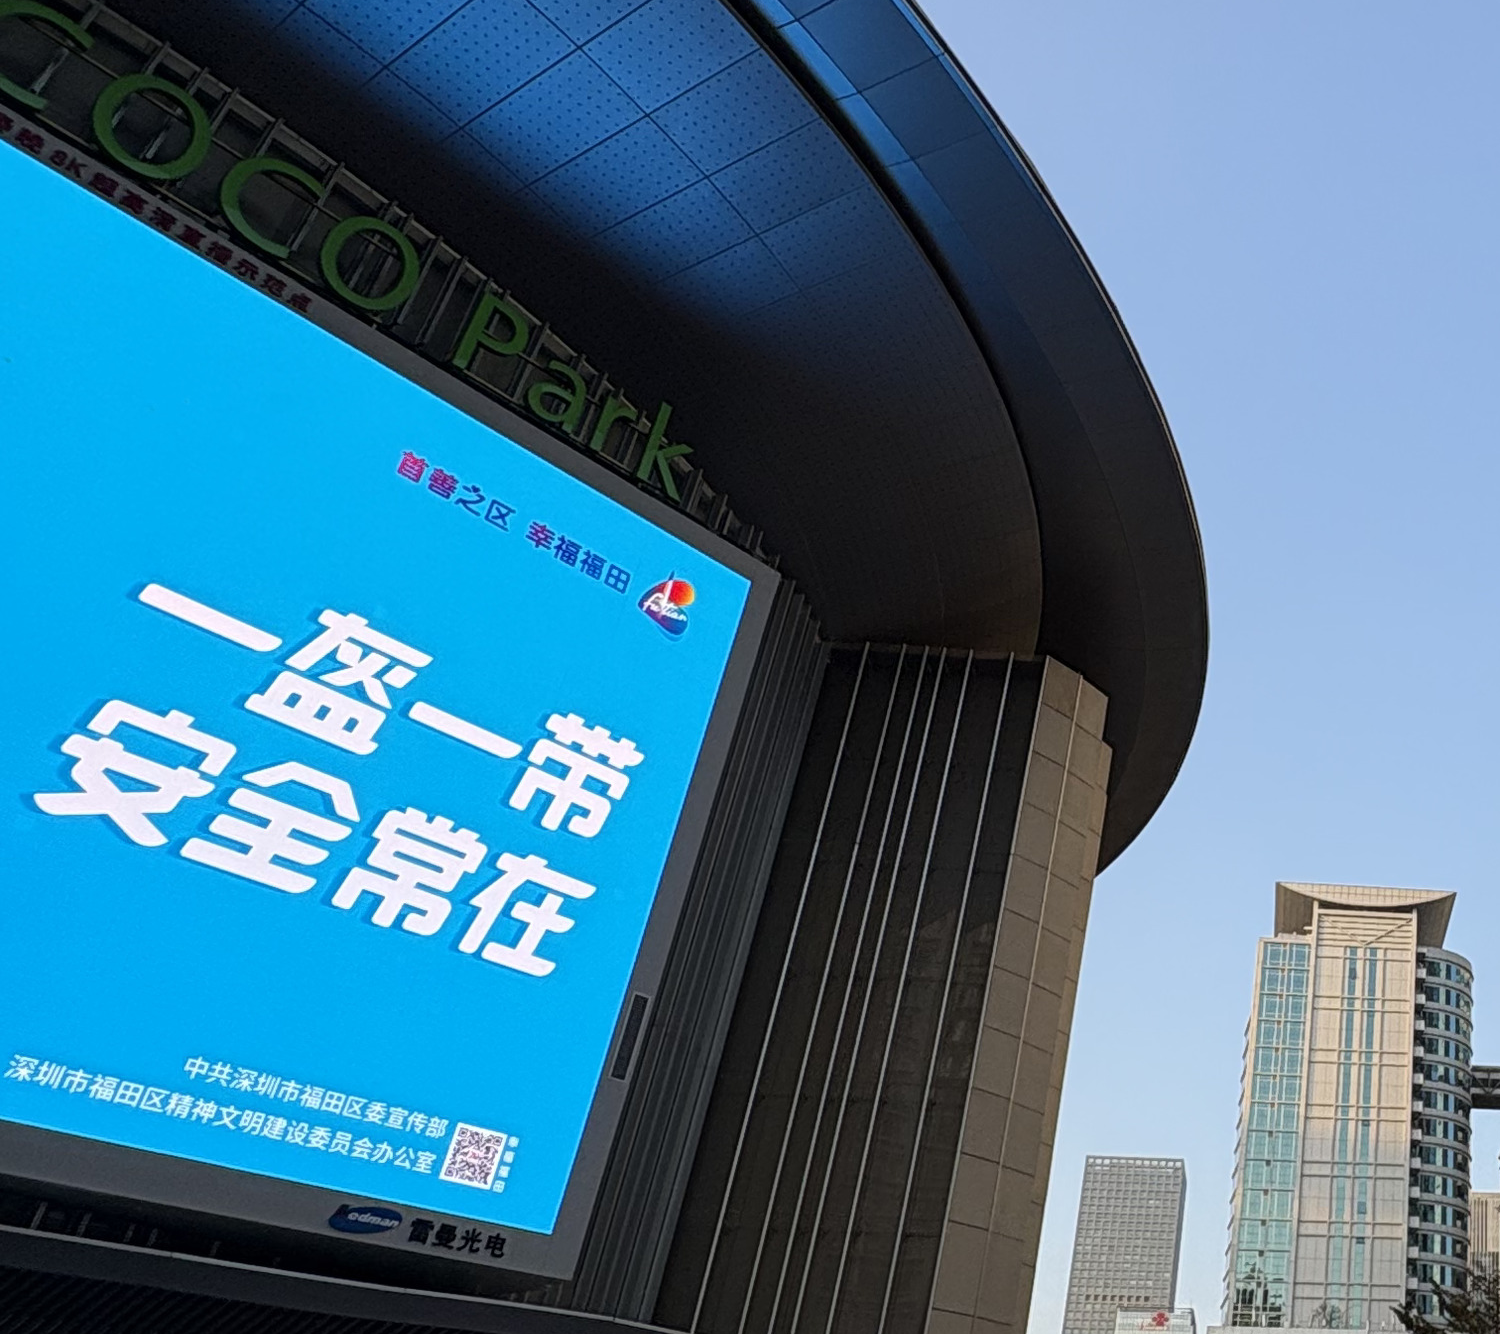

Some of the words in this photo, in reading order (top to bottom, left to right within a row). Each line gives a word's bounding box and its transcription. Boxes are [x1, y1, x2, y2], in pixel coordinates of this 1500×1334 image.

[451, 296, 695, 502] Park
[397, 450, 517, 533] 首善之区
[523, 520, 633, 595] 幸福福田
[138, 583, 645, 838] 一盔一带
[34, 699, 597, 977] 安全常在
[5, 1053, 437, 1175] 深圳市福田区精神文明建设委员会办公室
[183, 1055, 450, 1139] 中共深圳市福田区委宣传部
[407, 1218, 507, 1259] 雷曼光电
